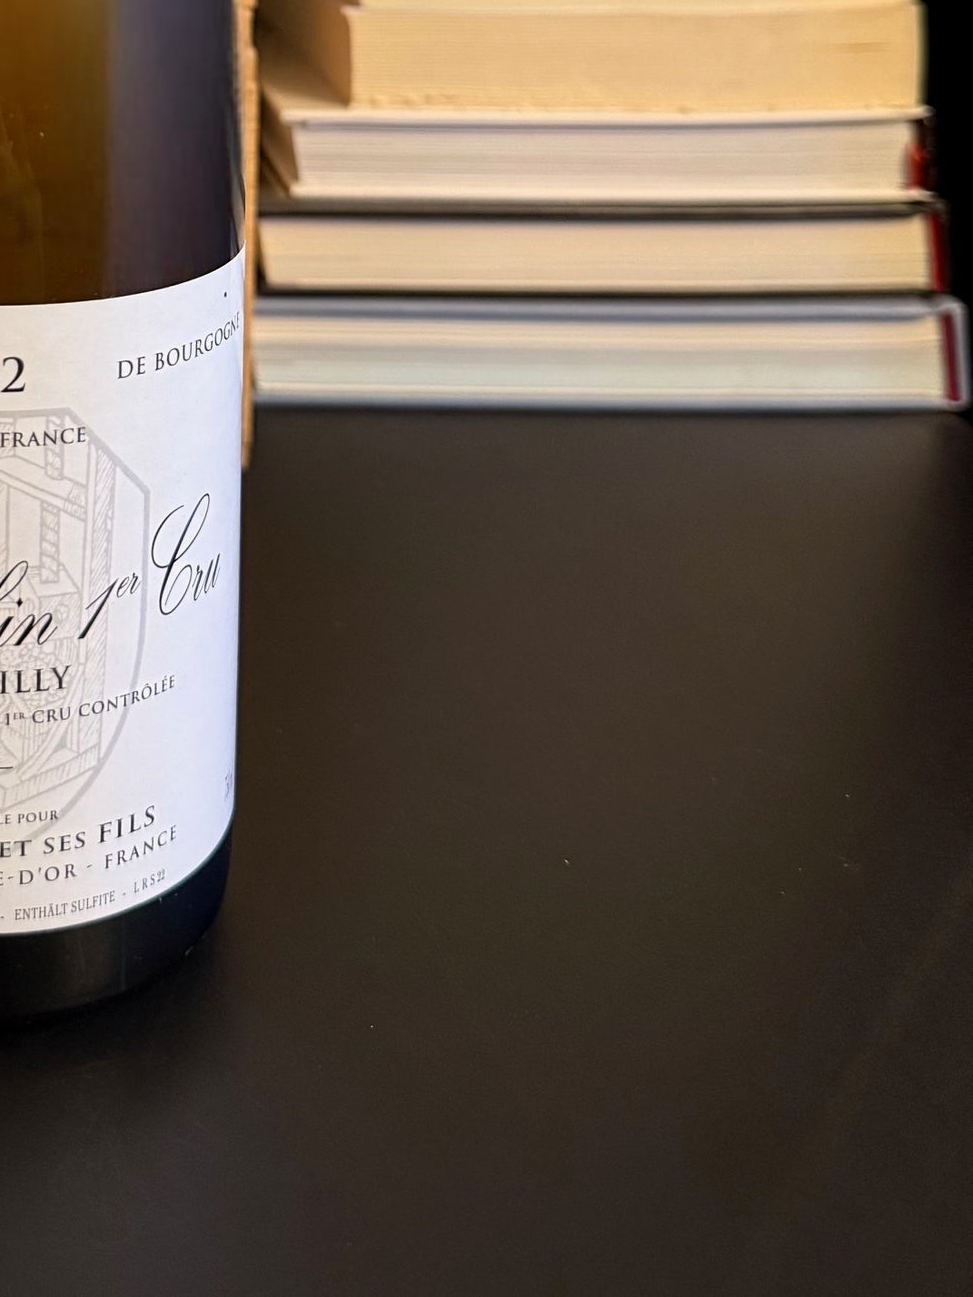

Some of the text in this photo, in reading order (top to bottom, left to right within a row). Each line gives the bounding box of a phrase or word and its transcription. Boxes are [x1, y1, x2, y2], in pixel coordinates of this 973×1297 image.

[117, 311, 240, 379] DE BOURGOGNE
[0, 426, 87, 448] FRANCE
[78, 572, 141, 640] 1er
[151, 493, 221, 615] Cru
[32, 707, 72, 724] CRU
[78, 674, 176, 717] CONTRÔLÉE
[0, 839, 32, 858] ET
[43, 831, 86, 855] SES
[98, 805, 156, 844] FILS
[17, 810, 59, 824] POUR
[105, 824, 177, 870] FRANCE
[14, 901, 68, 921] ENTHÄLT
[71, 890, 116, 913] SULFITE
